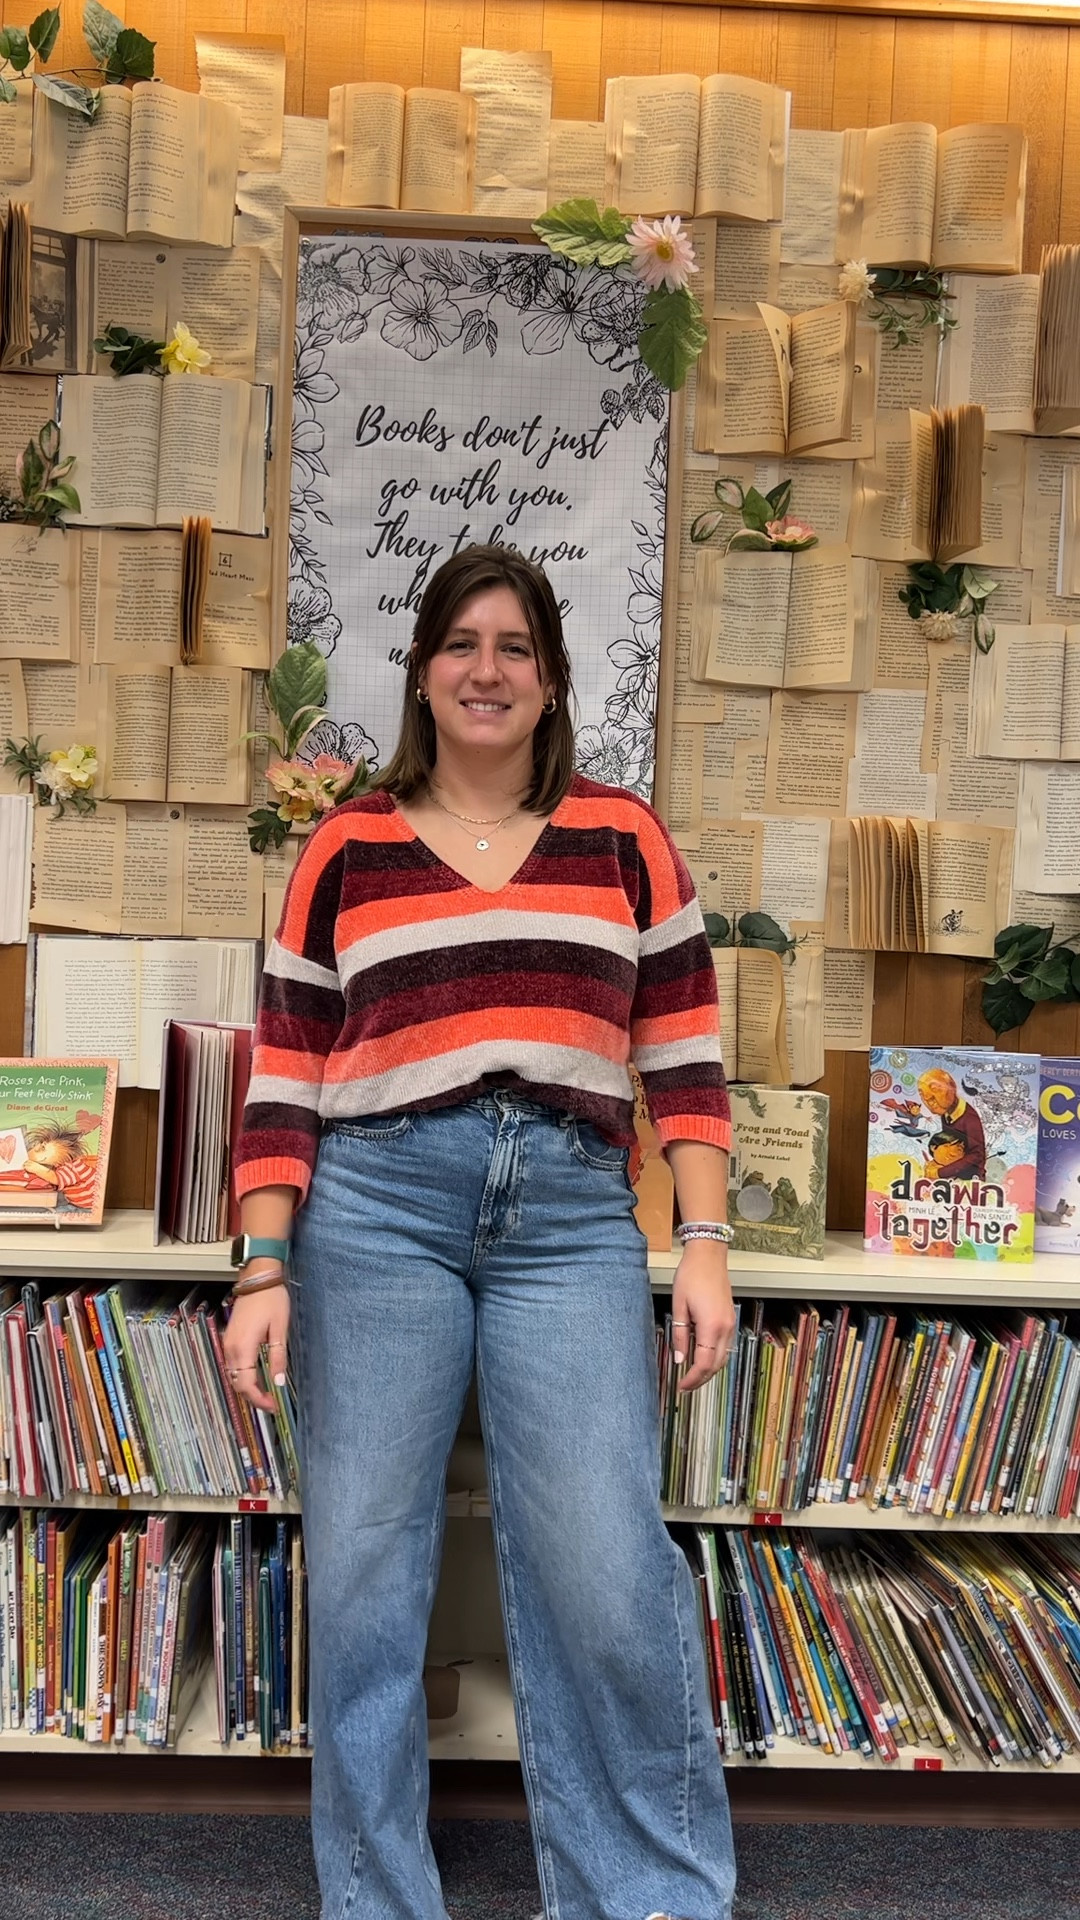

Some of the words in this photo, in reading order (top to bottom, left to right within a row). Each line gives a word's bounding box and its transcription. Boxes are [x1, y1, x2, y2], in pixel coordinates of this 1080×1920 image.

[355, 404, 454, 452] Books
[462, 414, 542, 459] don't
[536, 419, 610, 469] just
[378, 477, 421, 517] go
[430, 459, 501, 510] with
[506, 485, 573, 525] you.
[366, 509, 443, 577] They
[0, 1075, 33, 1086] Roses
[36, 1075, 56, 1086] Are
[58, 1075, 86, 1088] Pink,
[14, 1088, 34, 1098] Feet
[37, 1089, 66, 1102] Really
[67, 1090, 94, 1101] Stink
[1039, 1084, 1080, 1125] C
[6, 1103, 31, 1111] Diane
[733, 1122, 760, 1134] Frog
[762, 1126, 781, 1134] and
[783, 1127, 810, 1137] Toad
[1042, 1129, 1077, 1140] LOVES
[738, 1136, 761, 1145] Are
[762, 1137, 803, 1149] Friends
[891, 1160, 1004, 1208] drawn
[973, 1212, 987, 1220] DAN
[923, 1366, 939, 1403] ROBERTO
[249, 1501, 256, 1510] K
[764, 1515, 771, 1524] K
[8, 1591, 13, 1600] MY
[753, 1606, 761, 1619] I'm
[821, 1631, 829, 1641] WE
[825, 1641, 833, 1651] ARE
[830, 1625, 842, 1646] FRIENDS
[839, 1646, 847, 1656] ARE
[781, 1643, 794, 1665] GIFT
[863, 1632, 874, 1646] Frog
[880, 1668, 895, 1692] Together
[97, 1657, 105, 1689] SNOWY
[160, 1651, 169, 1686] DOUGHNUT
[856, 1643, 870, 1668] MOUSE
[866, 1668, 879, 1690] TALES
[915, 1670, 926, 1685] Frog
[922, 1684, 930, 1695] and
[927, 1695, 937, 1708] Toad
[97, 1693, 105, 1708] DAY
